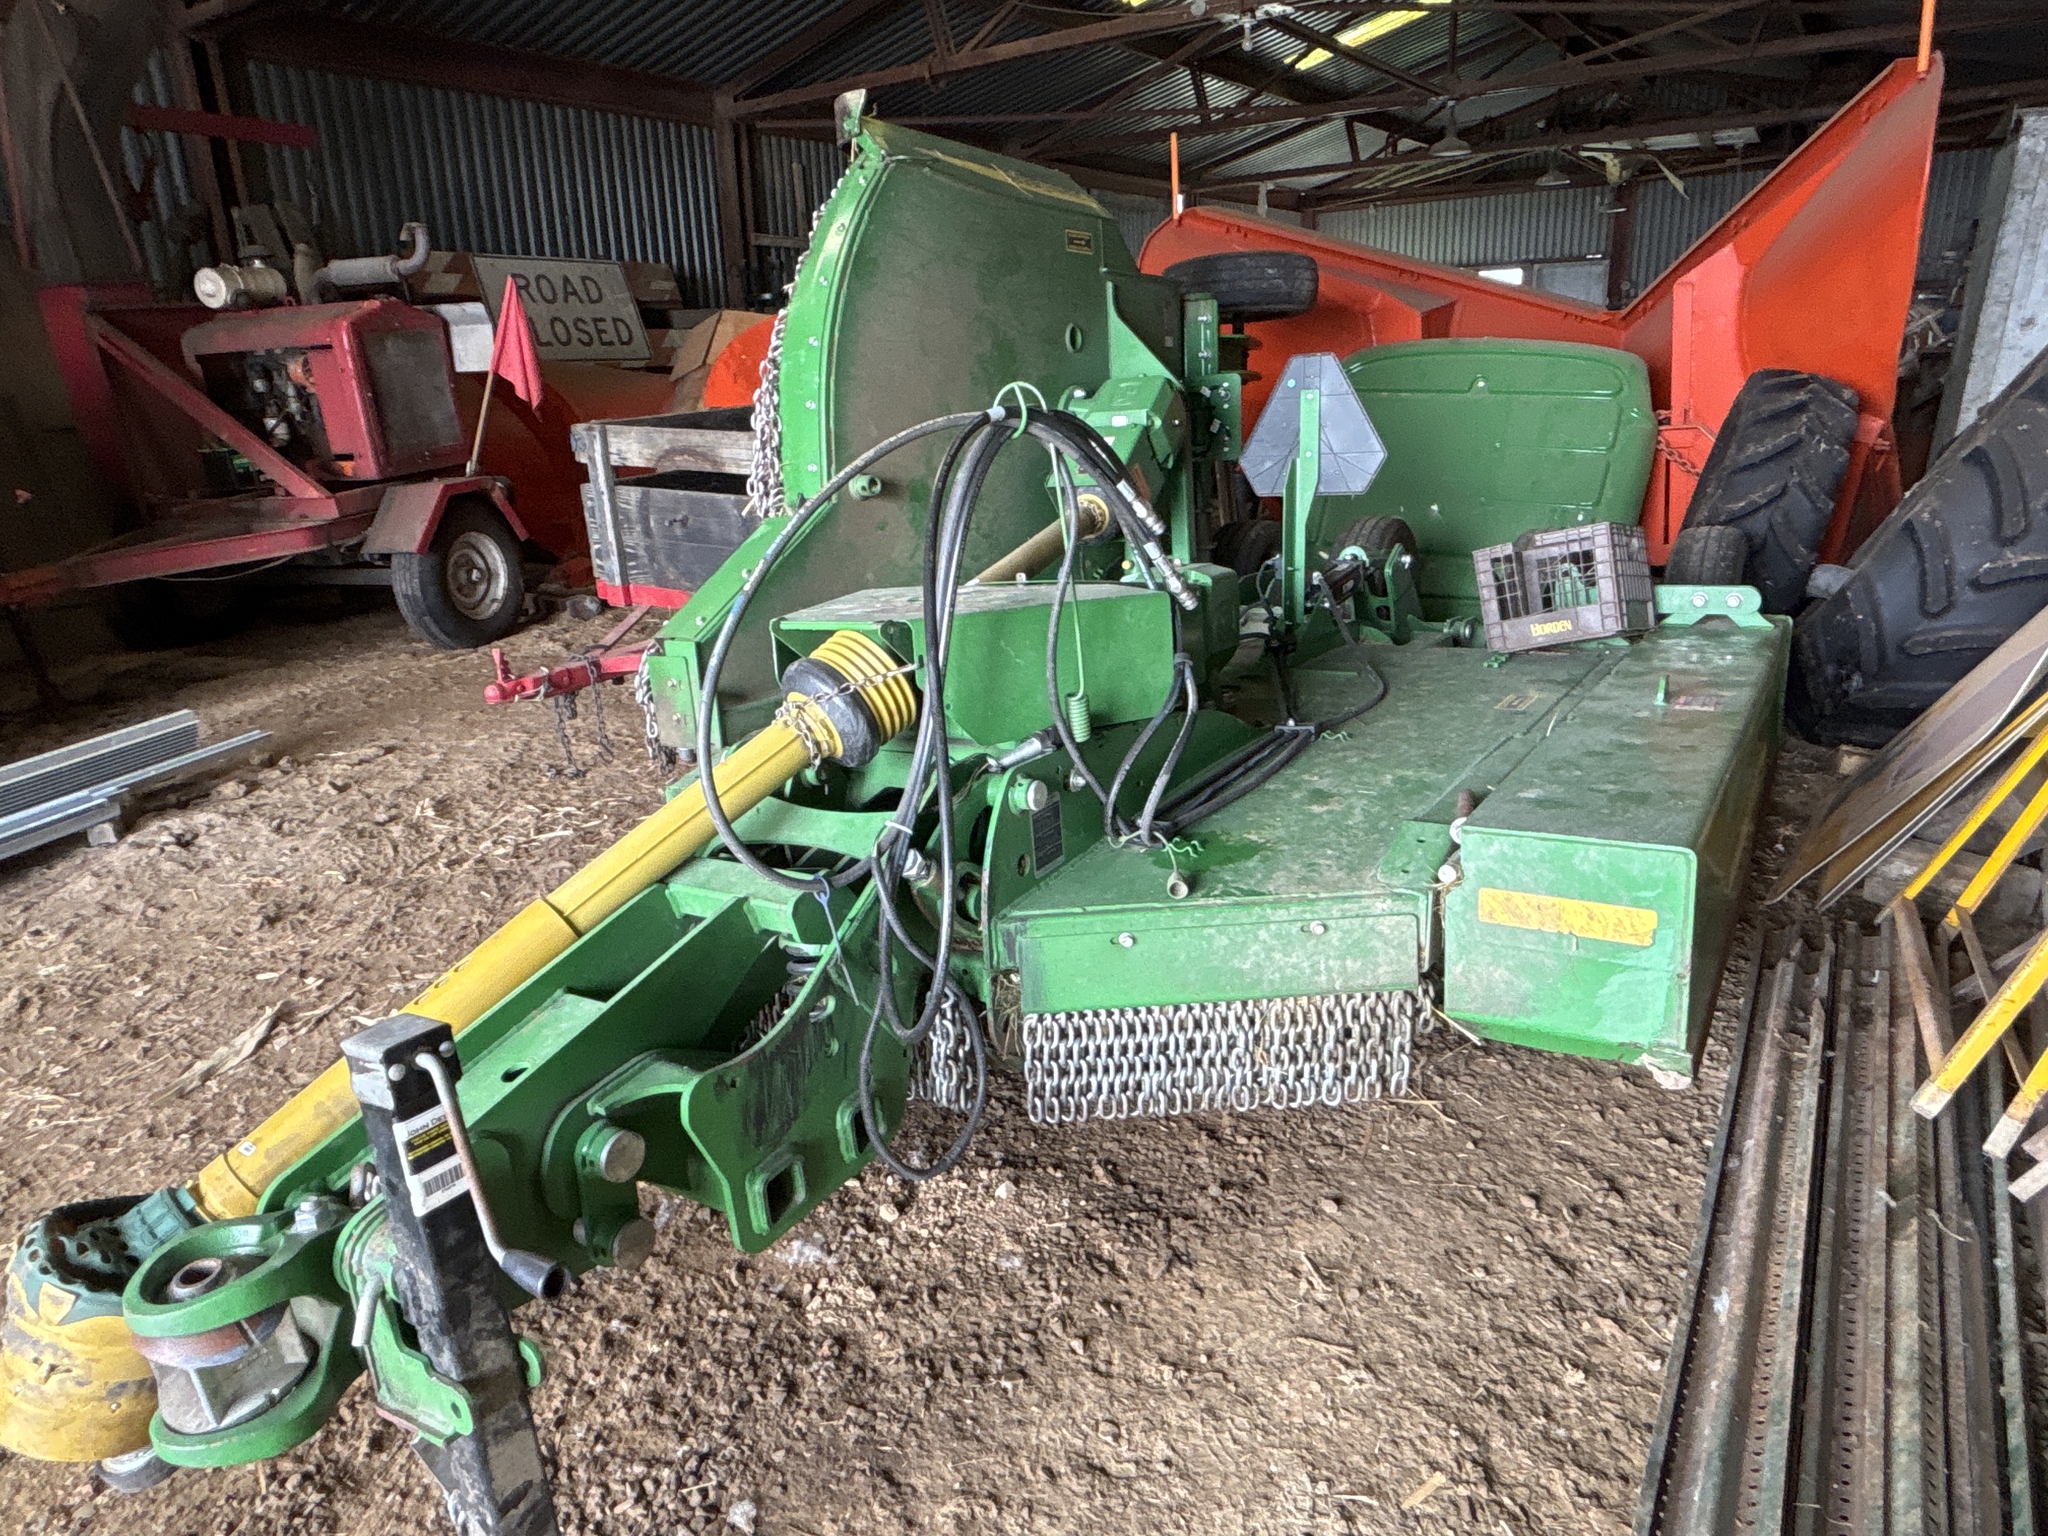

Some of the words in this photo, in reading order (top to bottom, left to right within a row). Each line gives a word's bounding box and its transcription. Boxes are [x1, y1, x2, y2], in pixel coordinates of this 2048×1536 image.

[511, 273, 603, 304] ROAD
[529, 316, 633, 347] LOSED
[407, 1122, 430, 1137] JOHN
